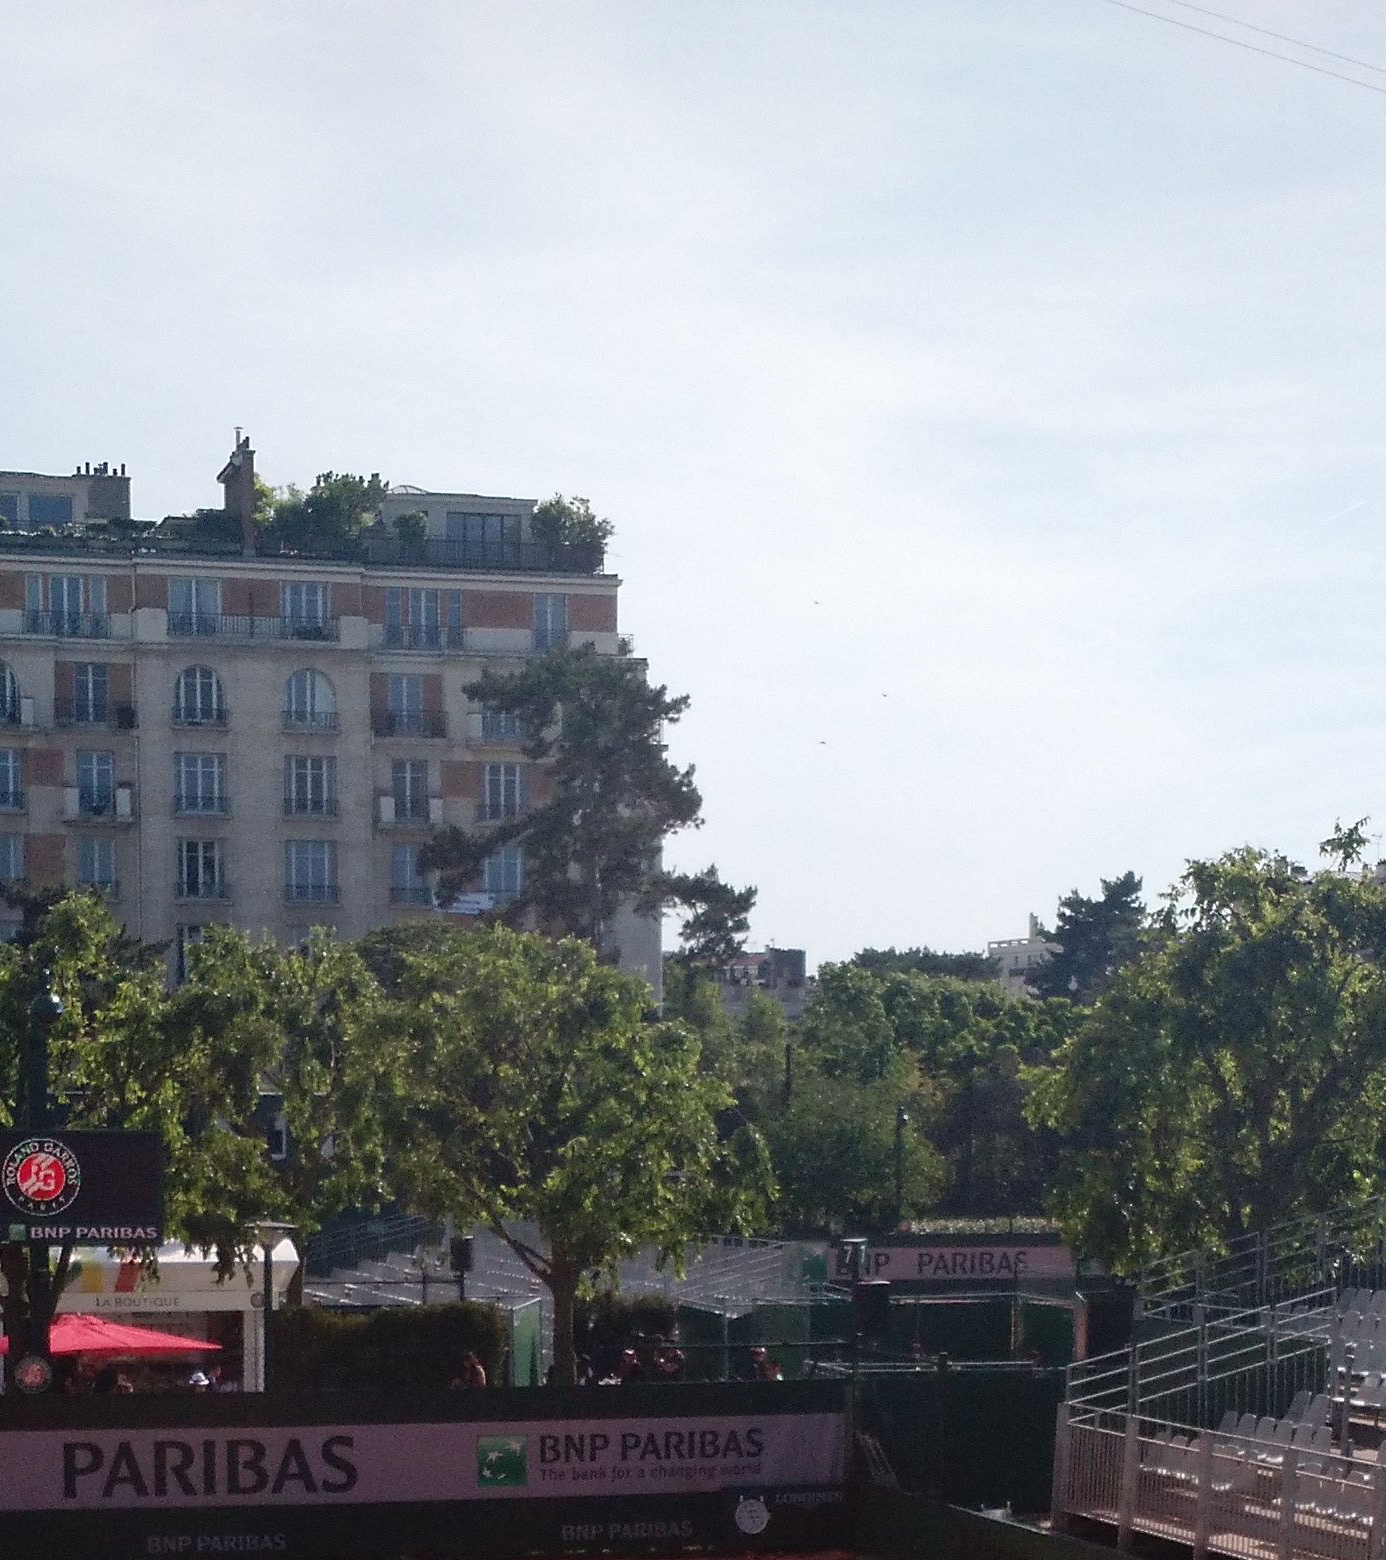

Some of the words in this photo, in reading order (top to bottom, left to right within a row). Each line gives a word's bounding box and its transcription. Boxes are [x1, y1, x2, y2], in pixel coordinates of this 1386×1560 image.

[6, 1142, 39, 1186] ROLAND
[44, 1142, 77, 1185] GARROS
[30, 1226, 71, 1239] BNP
[76, 1226, 157, 1239] PARIBAS
[115, 1297, 179, 1307] BOUTIQUE
[540, 1433, 609, 1464] BNP
[621, 1428, 763, 1461] PARIBAS
[62, 1435, 360, 1499] PARIBAS
[540, 1468, 566, 1481] The
[572, 1466, 606, 1481] bank
[611, 1466, 633, 1482] for
[638, 1469, 646, 1479] a
[650, 1464, 715, 1481] changing
[721, 1462, 761, 1476] world
[561, 1522, 603, 1542] BNP
[608, 1519, 693, 1540] PARIBAS
[147, 1535, 192, 1554] BNP
[197, 1533, 287, 1552] PARIBAS
